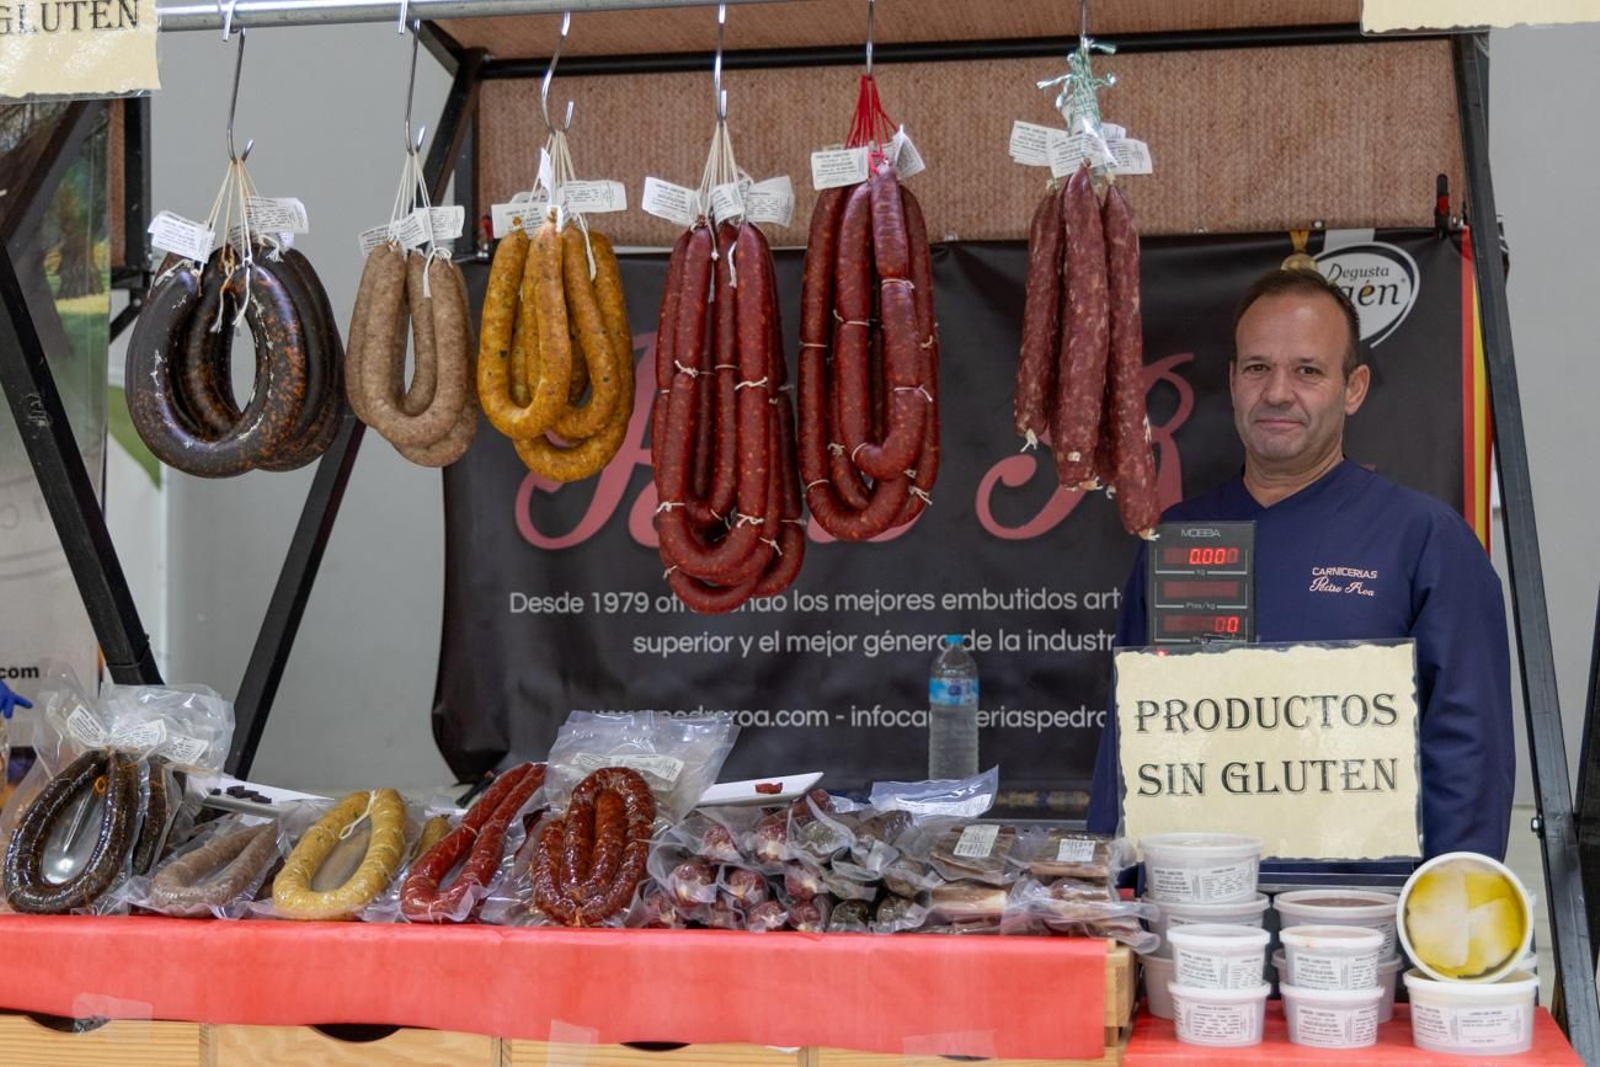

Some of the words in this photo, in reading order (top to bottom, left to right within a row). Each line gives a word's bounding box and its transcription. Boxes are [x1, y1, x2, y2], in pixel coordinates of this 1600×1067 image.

[0, 0, 139, 35] GLUTEN
[1327, 262, 1390, 281] Degusta
[1181, 528, 1221, 538] MOBBA
[1308, 576, 1343, 594] Pedro
[1311, 565, 1379, 580] CARNICERIAS
[509, 591, 585, 614] Desde
[592, 591, 650, 614] 1979
[793, 588, 829, 613] los
[834, 589, 936, 617] mejores
[941, 587, 1078, 611] embutidos
[632, 631, 735, 658] superior
[738, 635, 754, 658] y
[758, 630, 780, 653] el
[786, 630, 858, 658] mejor
[961, 629, 993, 652] de
[999, 629, 1021, 651] la
[1134, 693, 1399, 734] PRODUCTOS
[1137, 761, 1207, 796] SIN
[1220, 757, 1399, 795] GLUTEN
